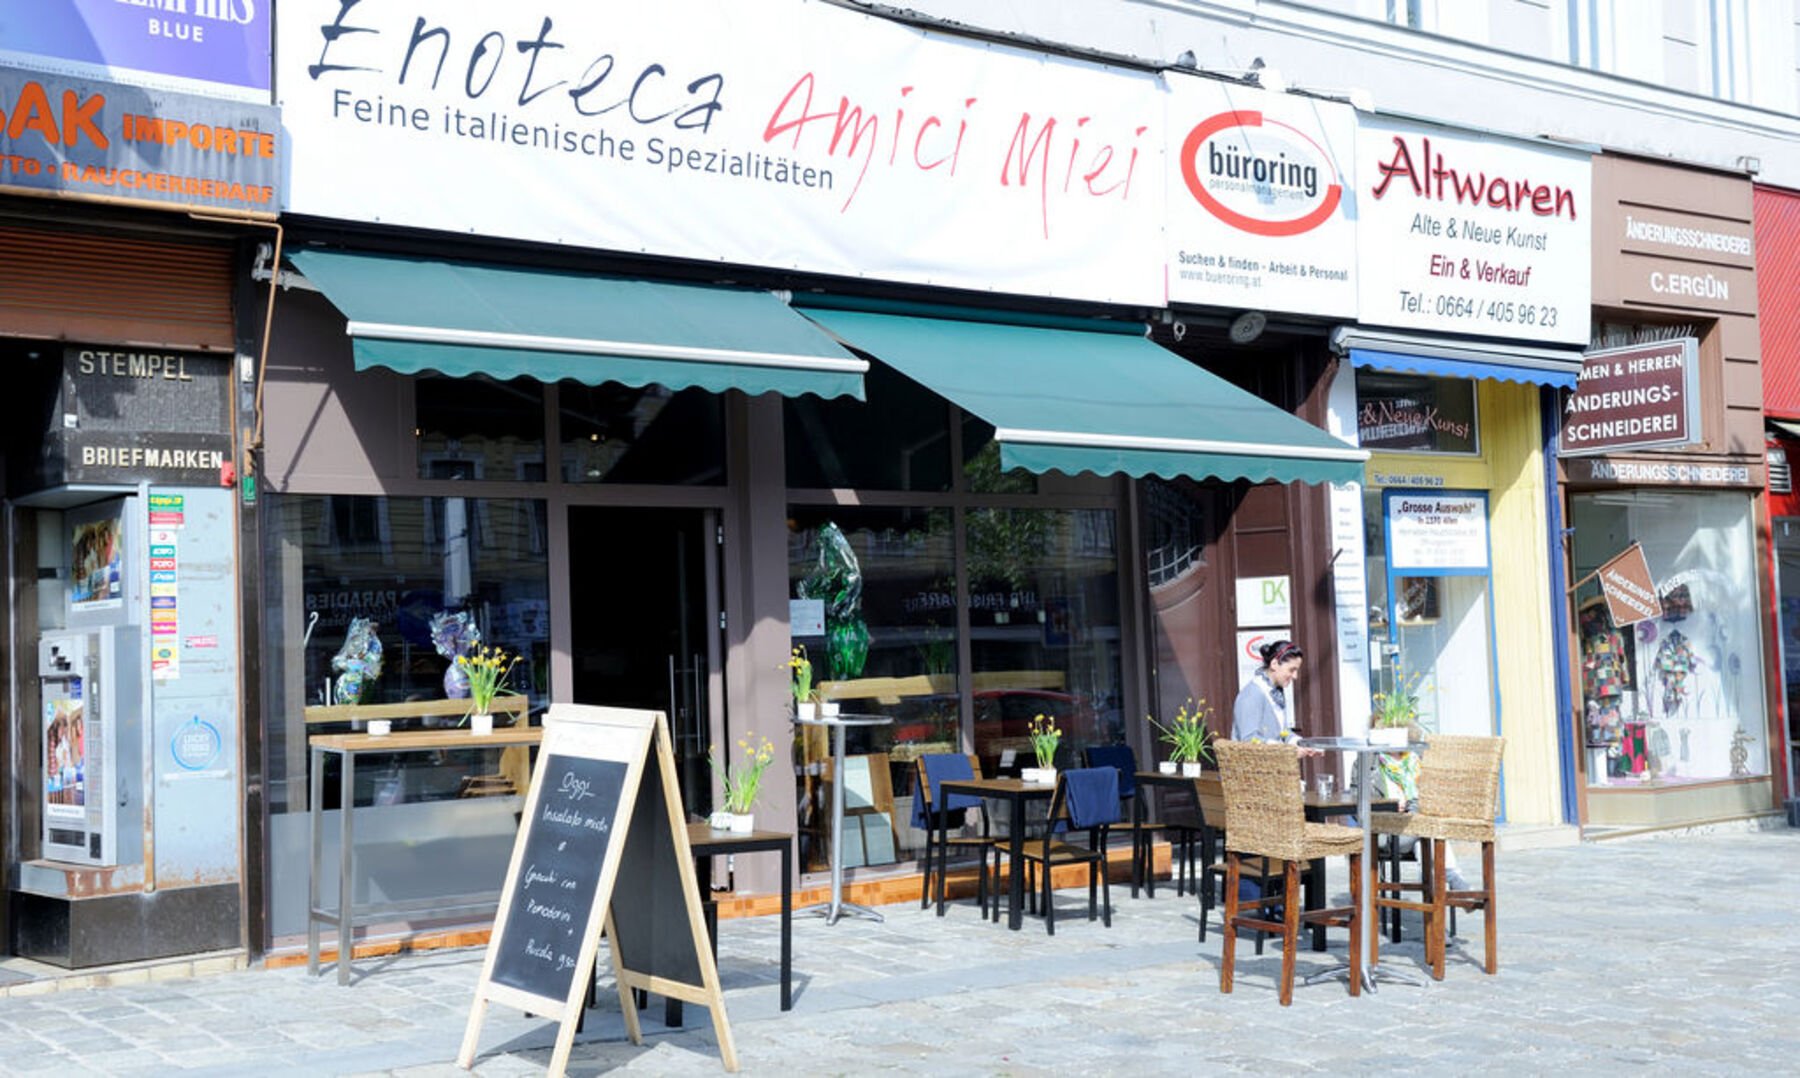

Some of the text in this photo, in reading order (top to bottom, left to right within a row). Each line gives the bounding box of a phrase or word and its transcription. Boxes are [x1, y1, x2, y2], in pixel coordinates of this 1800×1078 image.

[148, 18, 204, 43] BLUE
[0, 81, 275, 159] AK IMPORTE
[308, 0, 1148, 240] Enoteca Amici Miei
[333, 89, 834, 190] Feine italienische Spezialitäten
[62, 160, 274, 204] RAUCHERBEDARF
[1208, 141, 1318, 198] büroring
[1372, 135, 1577, 221] Altwaren
[1208, 178, 1305, 201] personalmanagement
[1410, 212, 1549, 251] Alte & Neue Kunst
[1625, 216, 1751, 256] ÄNDERUNGSSCHNEIDEREI
[1178, 251, 1216, 267] Suchen
[1218, 255, 1226, 268] &
[1228, 256, 1260, 272] finden
[1268, 261, 1298, 276] Arbeit
[1299, 263, 1307, 277] &
[1309, 265, 1349, 281] Personal
[1430, 254, 1532, 287] Ein & Verkauf
[1650, 271, 1729, 300] C.ERGÜN
[1399, 290, 1559, 328] Tel.: 0664 / 405 96 23
[79, 351, 193, 381] STEMPEL
[1576, 353, 1683, 382] MEN & HERREN
[1564, 384, 1680, 414] ÄNDERUNGS-
[1363, 401, 1377, 425] &
[1378, 399, 1424, 427] Neue
[1426, 404, 1470, 441] Kunst
[1566, 414, 1679, 443] SCHNEIDEREI
[82, 446, 224, 470] BRIEFMARKEN
[1590, 460, 1749, 483] ÄNDERUNGSSCHNEIDEREI
[562, 771, 592, 801] Oggi
